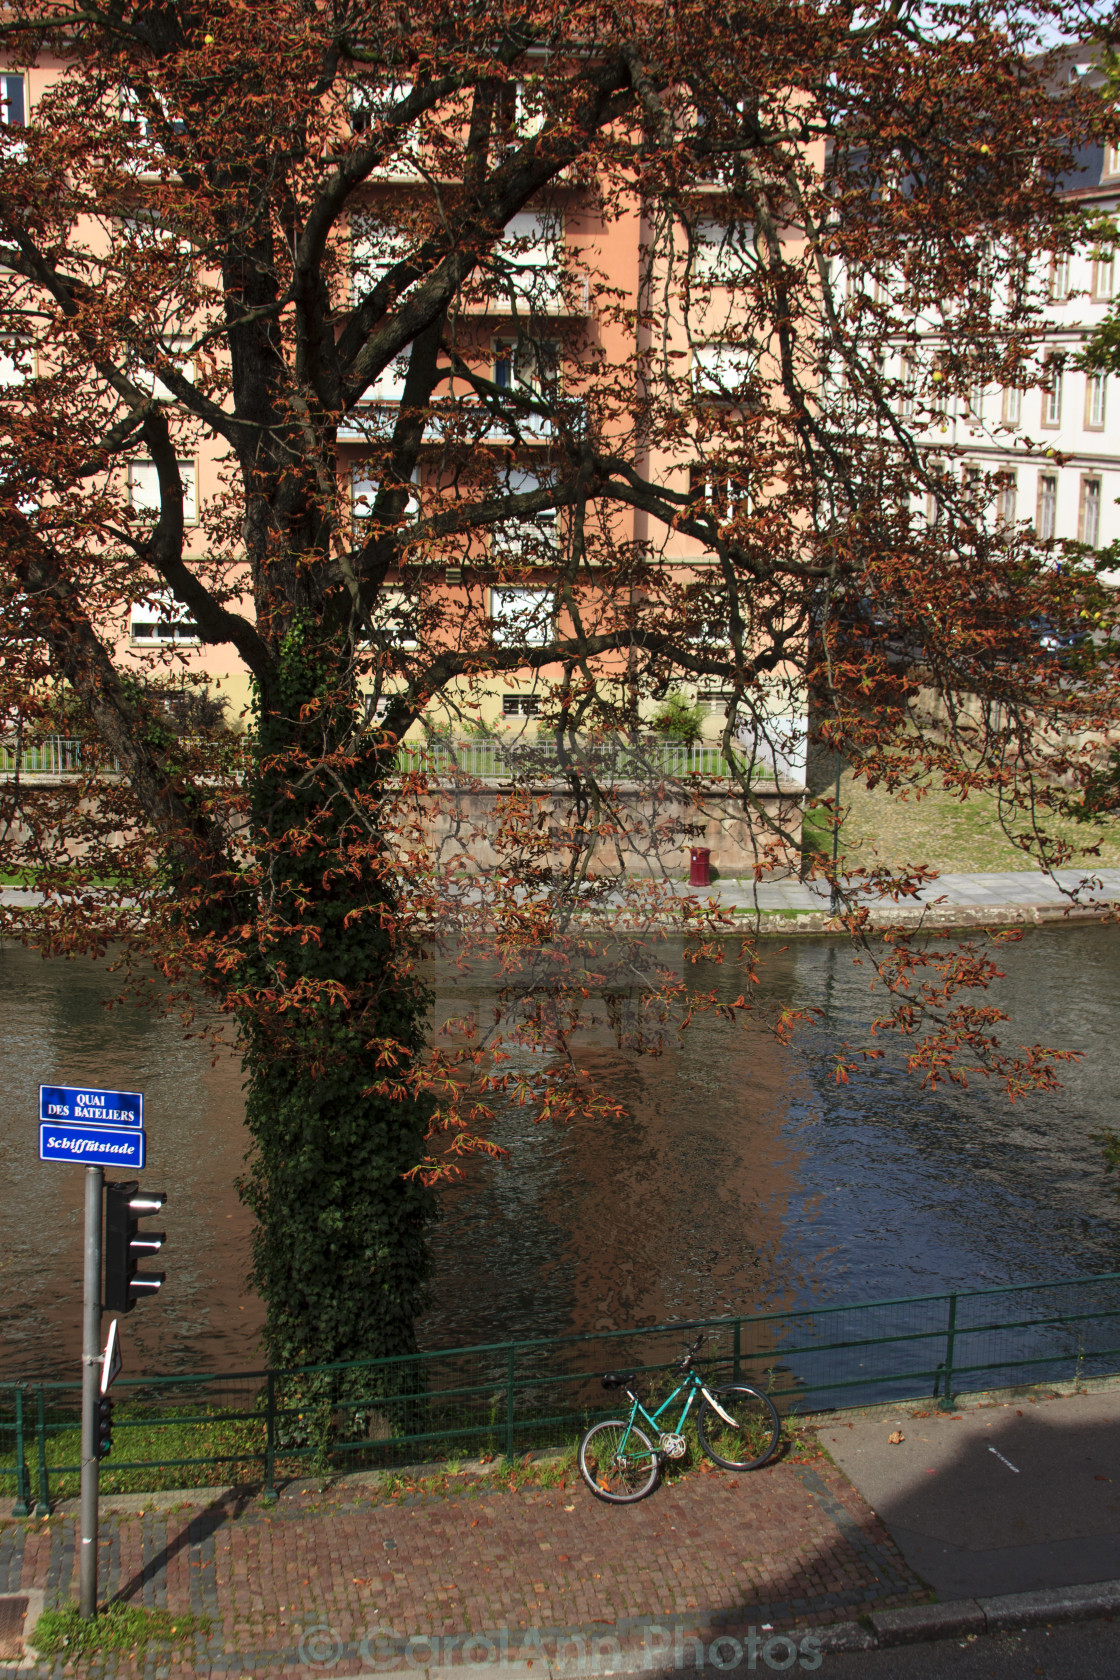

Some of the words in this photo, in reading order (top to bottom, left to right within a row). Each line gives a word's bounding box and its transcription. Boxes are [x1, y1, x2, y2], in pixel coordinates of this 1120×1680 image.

[76, 1094, 105, 1106] QUAI
[47, 1104, 70, 1116] DES
[74, 1106, 134, 1121] BATELIERS
